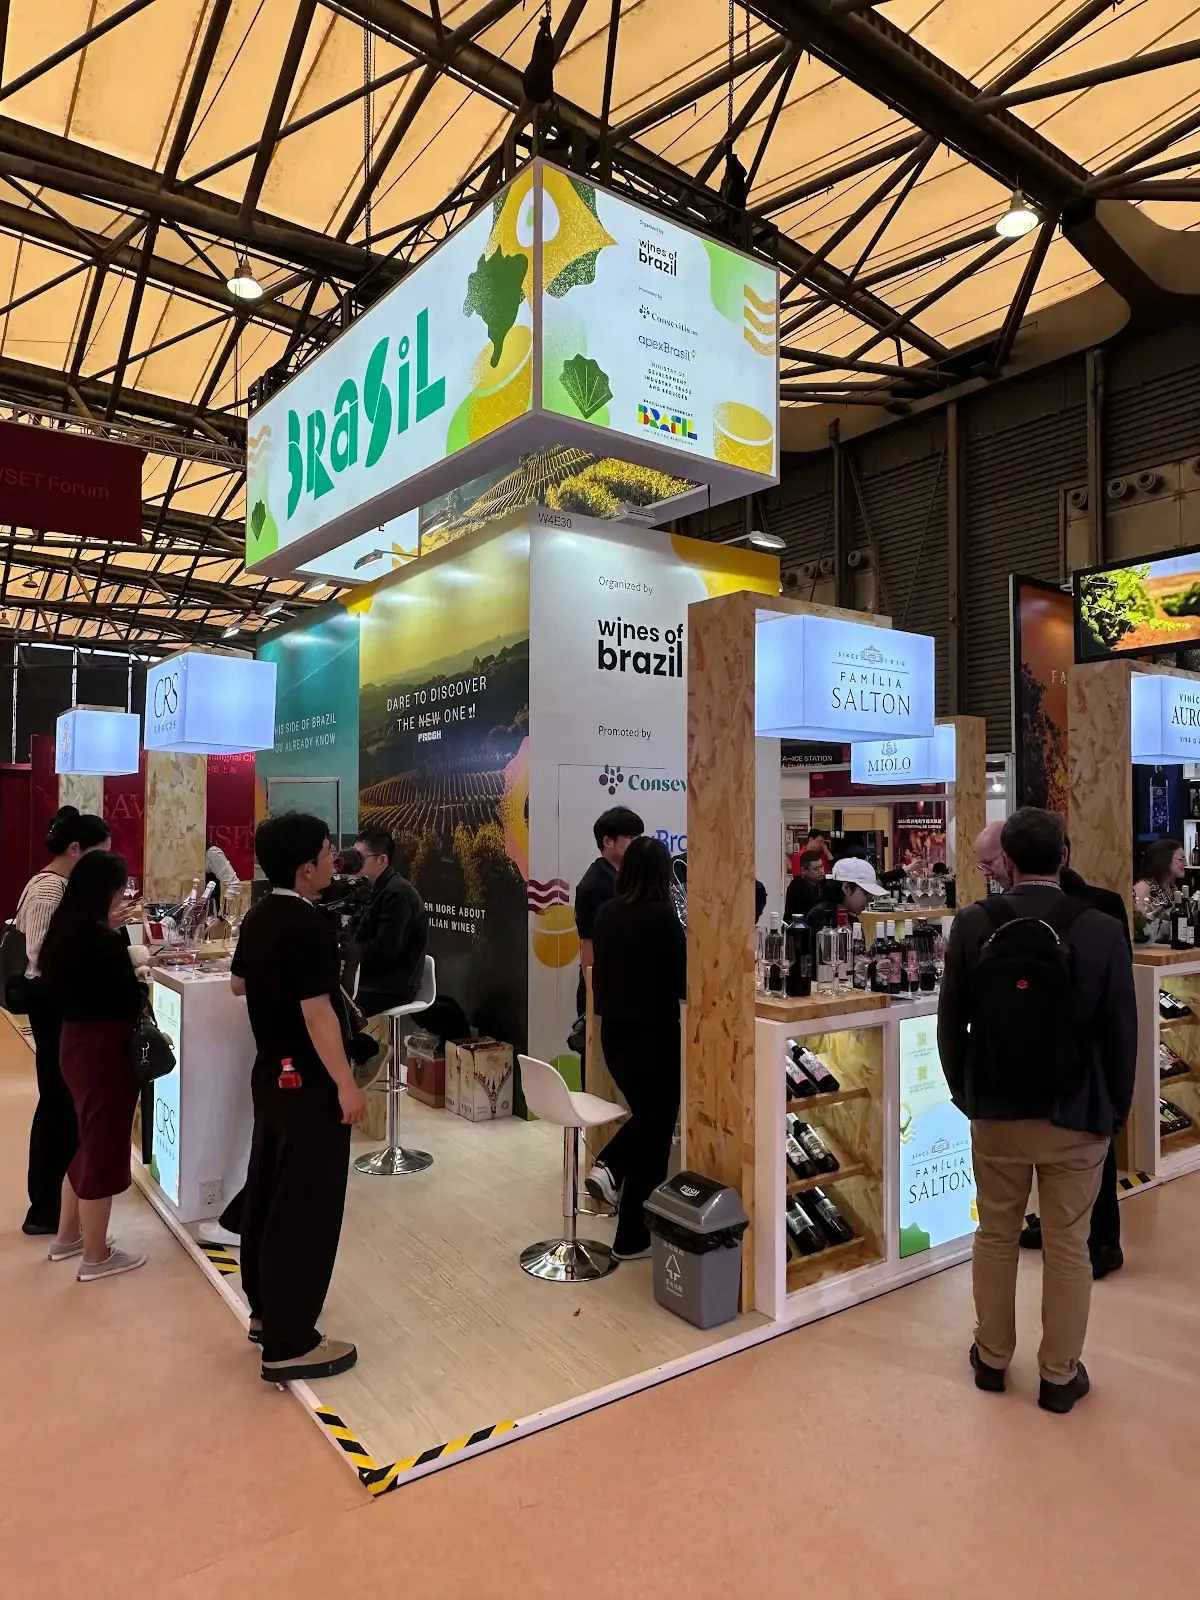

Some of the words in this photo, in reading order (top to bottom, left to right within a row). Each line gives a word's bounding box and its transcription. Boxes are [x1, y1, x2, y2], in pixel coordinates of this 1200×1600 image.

[639, 239, 666, 257] wines
[669, 251, 677, 260] of
[639, 248, 676, 276] brazil
[638, 335, 690, 362] apexBrasil
[652, 362, 676, 374] MINISTRY
[662, 388, 688, 400] SERVICES
[675, 386, 692, 395] TRADE
[0, 467, 42, 488] SET
[48, 475, 109, 499] Forum
[539, 513, 572, 528] W4E30
[599, 576, 641, 592] Organized
[644, 584, 653, 596] by
[598, 617, 660, 646] wines
[665, 624, 683, 644] of
[598, 640, 682, 678] brazil
[838, 652, 859, 660] SINCE
[840, 672, 902, 688] FAMÍLIA
[154, 673, 179, 718] CRS
[387, 694, 410, 712] DARE
[414, 690, 426, 705] TO
[430, 676, 487, 702] DISCOVER
[832, 687, 910, 716] SALTON
[286, 720, 300, 733] SIDE
[302, 718, 310, 730] OF
[312, 713, 336, 728] BRAZIL
[397, 716, 415, 731] THE
[418, 711, 440, 727] NEW
[285, 736, 313, 752] ALREADY
[316, 732, 336, 746] KNOW
[598, 725, 639, 737] Promoted
[642, 728, 651, 740] by
[868, 757, 911, 772] MIOLO
[436, 904, 456, 915] MORE
[459, 907, 486, 919] ABOUT
[451, 921, 476, 934] WINES
[909, 1168, 971, 1204] SALTON
